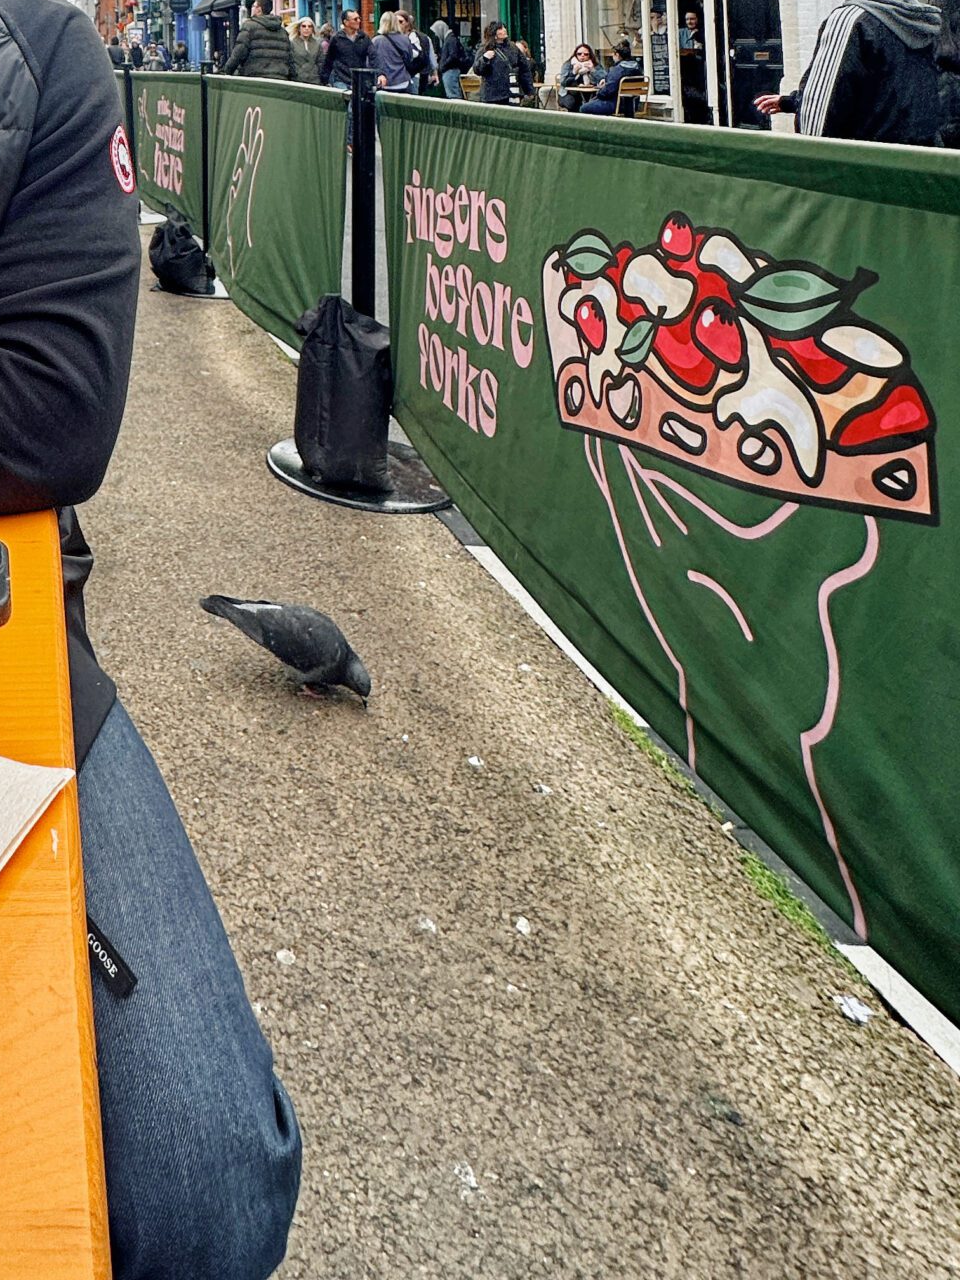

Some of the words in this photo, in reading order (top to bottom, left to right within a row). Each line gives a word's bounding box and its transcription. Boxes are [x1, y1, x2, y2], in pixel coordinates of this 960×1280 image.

[153, 142, 183, 195] here
[403, 169, 508, 264] fingers
[425, 252, 534, 369] before
[417, 322, 499, 439] forks
[87, 932, 119, 978] GOOSE
